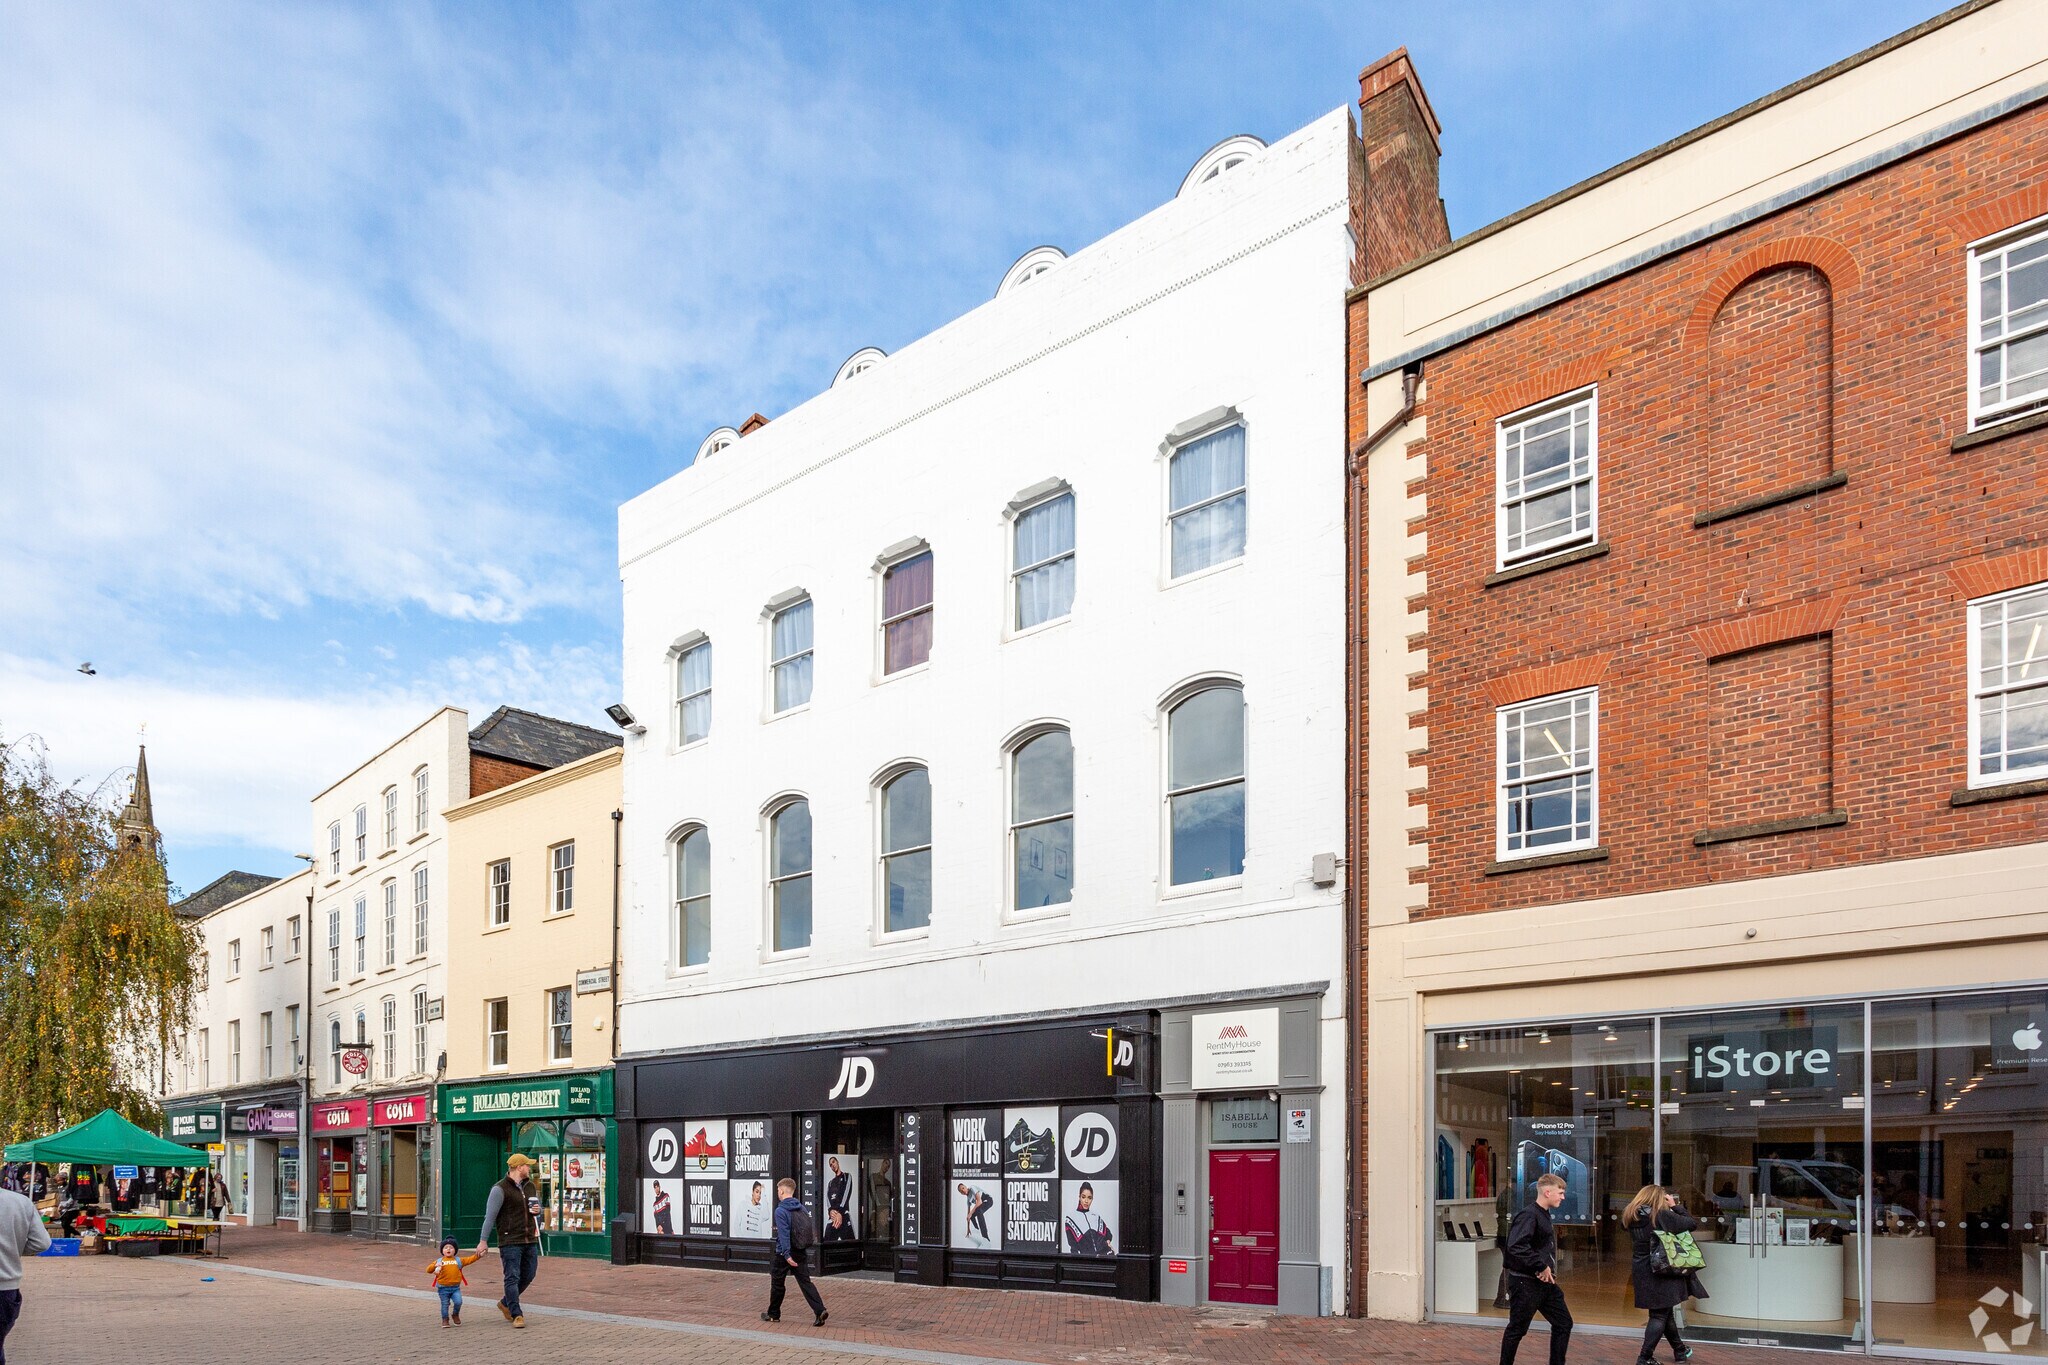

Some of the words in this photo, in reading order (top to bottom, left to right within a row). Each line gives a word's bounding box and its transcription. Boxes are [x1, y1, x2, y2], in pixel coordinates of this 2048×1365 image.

[578, 978, 597, 986] COMMERCIAL
[1113, 1039, 1134, 1066] JD
[1206, 1040, 1262, 1050] RentMyHouse
[346, 1052, 363, 1060] COSTA
[1694, 1045, 1831, 1079] iStore
[345, 1062, 366, 1073] COFFEE
[828, 1056, 875, 1100] JD
[570, 1086, 591, 1094] HOLLAND
[452, 1096, 467, 1105] health
[472, 1093, 510, 1111] HOLLAND
[511, 1091, 520, 1110] &
[520, 1089, 561, 1107] BARRETT
[570, 1097, 591, 1105] BARRETT
[273, 1111, 295, 1119] GAME
[327, 1110, 350, 1126] COSTA
[386, 1102, 414, 1120] COSTA
[453, 1106, 466, 1114] foods
[1221, 1112, 1269, 1121] ISABELLA
[735, 1121, 764, 1139] OPENING
[953, 1118, 986, 1142] WORK
[652, 1139, 674, 1162] JD
[735, 1139, 751, 1155] THIS
[1070, 1127, 1110, 1158] JD
[953, 1141, 981, 1165] WITH
[983, 1141, 999, 1165] US
[735, 1154, 770, 1171] SATURDAY
[690, 1185, 714, 1205] WORK
[1007, 1181, 1049, 1202] OPENING
[690, 1205, 709, 1224] WITH
[711, 1204, 722, 1225] US
[1007, 1201, 1029, 1221] THIS
[1007, 1221, 1057, 1242] SATURDAY
